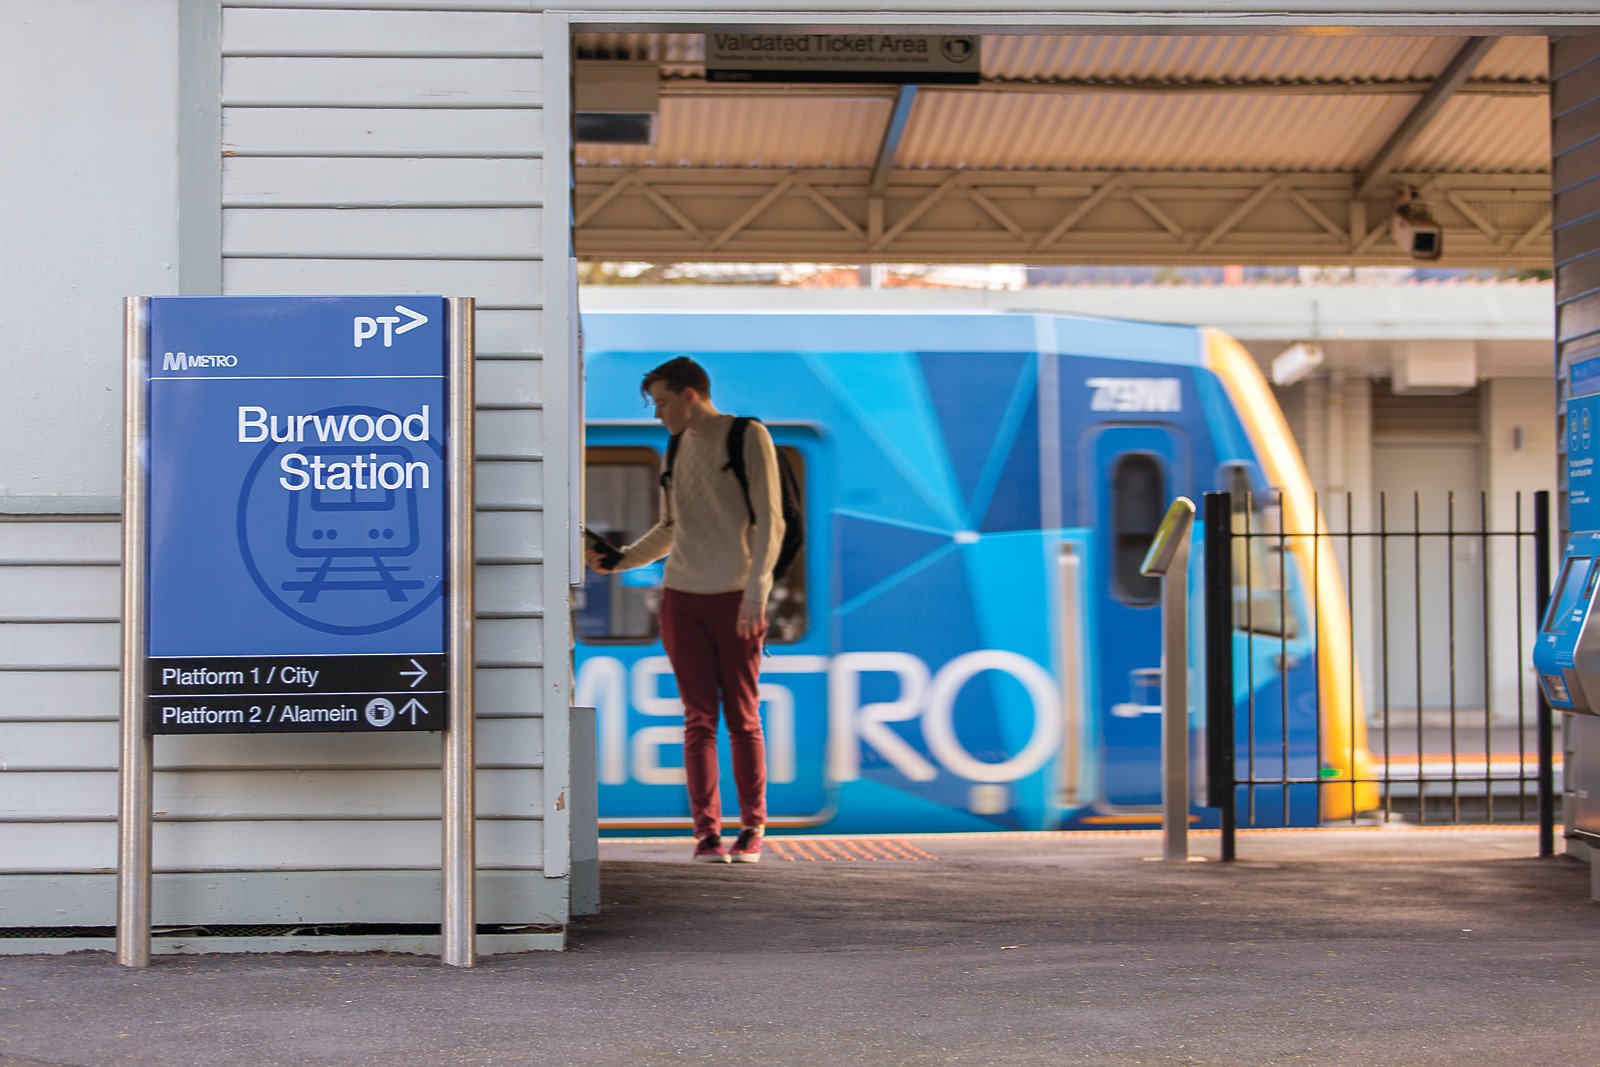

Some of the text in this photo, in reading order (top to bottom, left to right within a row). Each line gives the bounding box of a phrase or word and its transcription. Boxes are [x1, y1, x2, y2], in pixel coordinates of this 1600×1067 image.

[713, 34, 929, 53] Validated Ticket Area
[239, 405, 429, 442] Burwood
[280, 453, 429, 490] Station
[163, 668, 243, 685] Platform
[251, 668, 258, 683] 1
[281, 667, 319, 687] City
[163, 707, 243, 723] Platform
[250, 706, 261, 722] 2
[280, 705, 357, 722] Alamein
